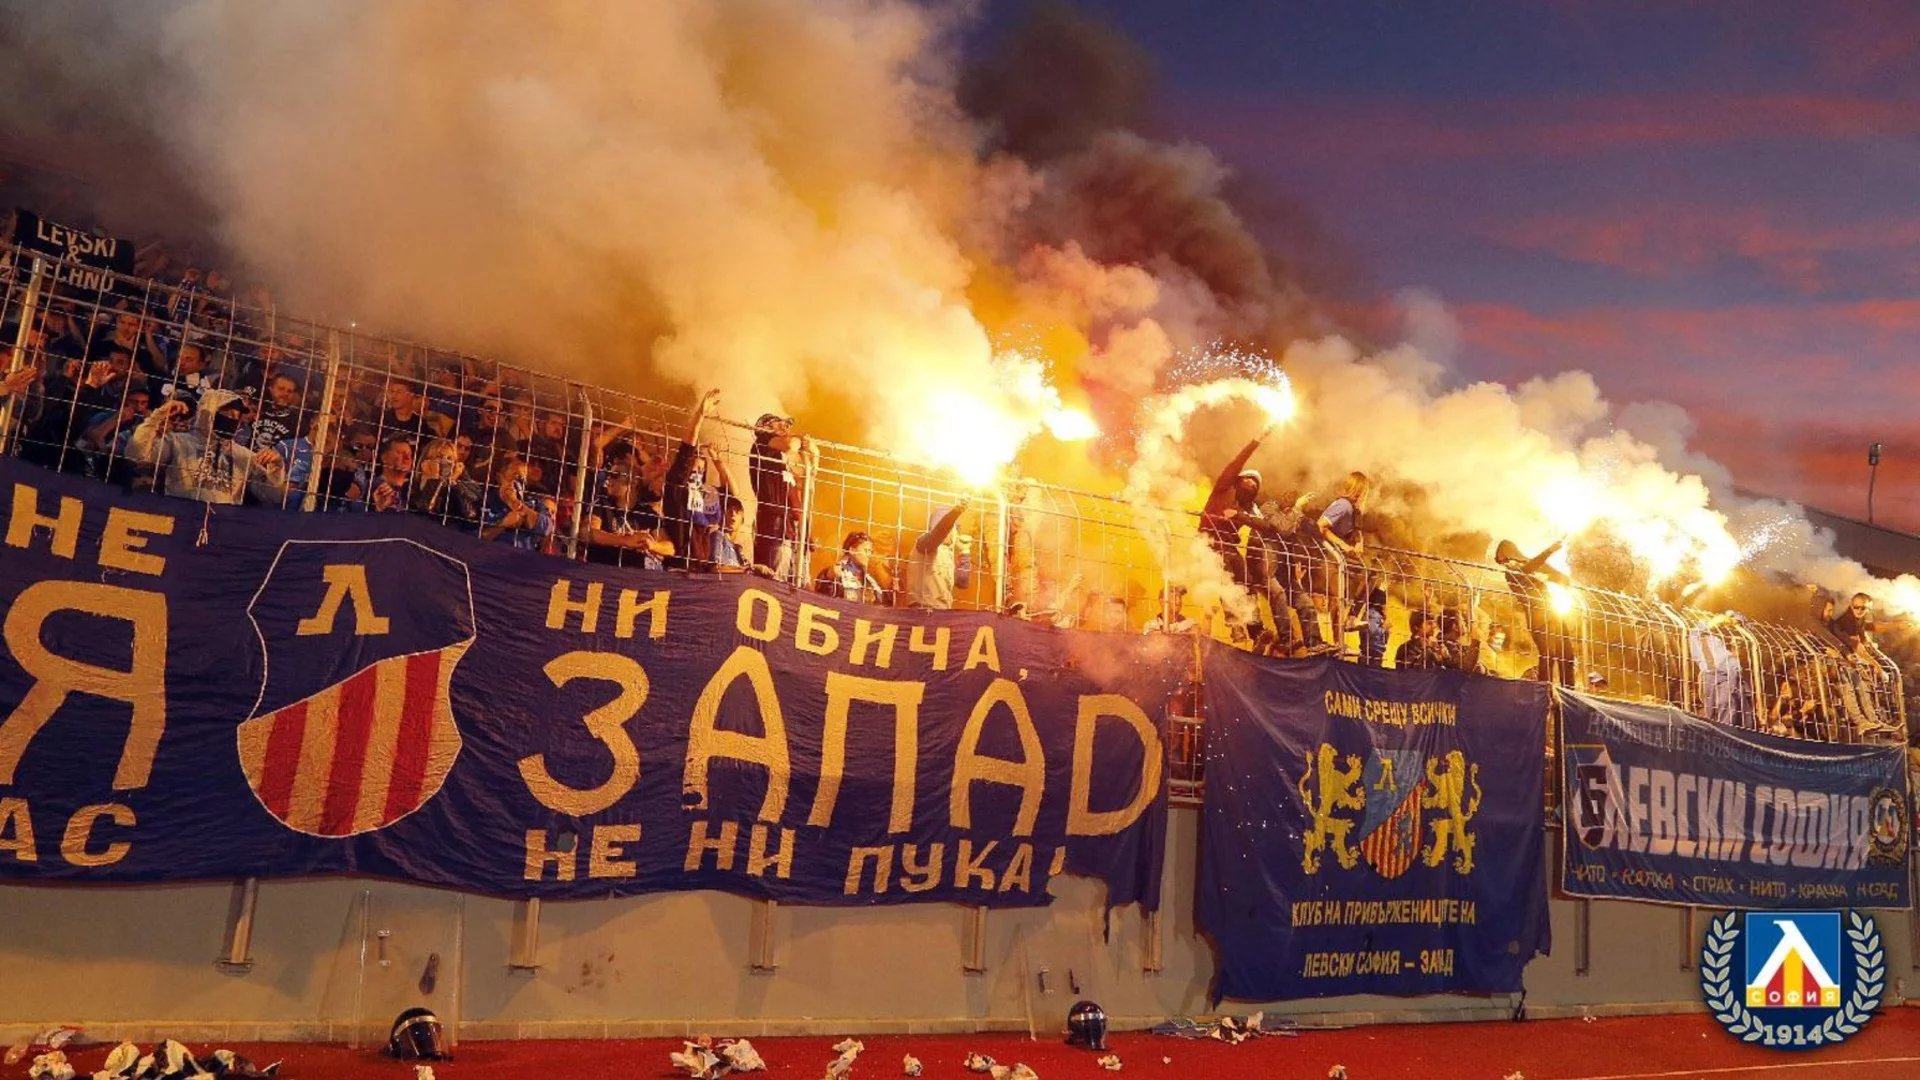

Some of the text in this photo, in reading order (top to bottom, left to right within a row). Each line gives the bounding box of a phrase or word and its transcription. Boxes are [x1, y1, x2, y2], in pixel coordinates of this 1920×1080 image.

[37, 219, 117, 257] LEVSKI
[66, 244, 82, 263] &
[34, 258, 115, 293] ECHNO
[5, 483, 175, 576] НЕ
[545, 578, 1028, 681] НИ ОБИЧА,
[0, 579, 168, 791] Я
[1324, 690, 1456, 730] САМИ СРЕЩУ ВСИЧКИ
[1600, 764, 1747, 861] ЛЕВСКИ
[524, 823, 641, 881] НЕ
[683, 820, 796, 879] НИ
[1692, 876, 1735, 894] СТРАХ
[1750, 880, 1787, 899] НИТО
[1292, 901, 1322, 927] КЛУБ
[1325, 901, 1341, 925] НА
[1461, 900, 1476, 925] НА
